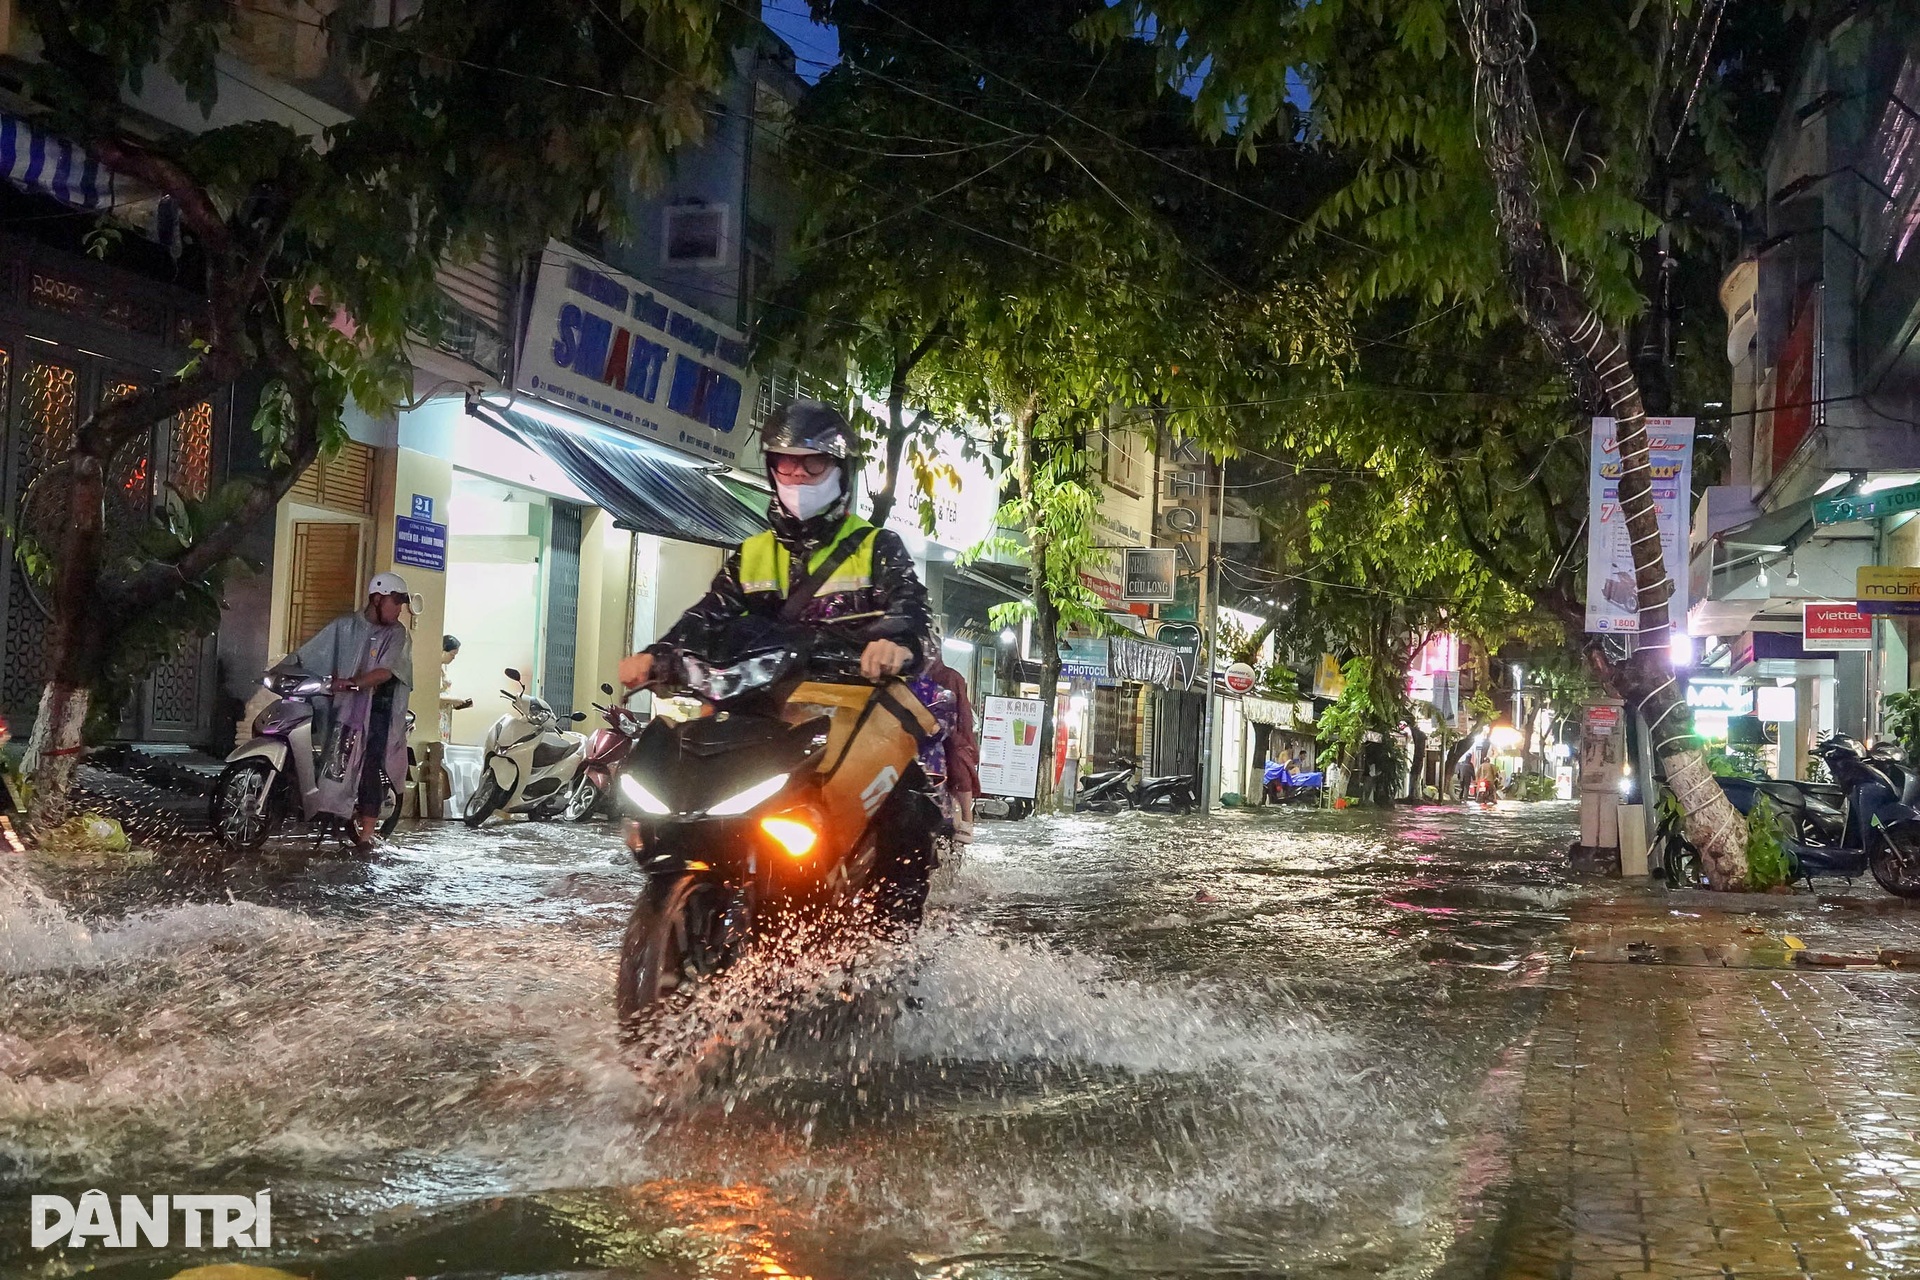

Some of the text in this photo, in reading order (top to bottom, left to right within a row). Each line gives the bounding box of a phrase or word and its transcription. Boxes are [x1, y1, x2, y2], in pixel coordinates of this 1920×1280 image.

[552, 304, 669, 404] SMART
[415, 497, 430, 512] 21
[946, 507, 957, 523] TEA
[1129, 577, 1168, 593] CỬU LONG
[1817, 610, 1863, 620] viettel
[1614, 619, 1635, 627] 1800
[1810, 625, 1826, 634] ĐIỂM
[1176, 646, 1193, 654] LONG
[1067, 664, 1106, 676] PHOTOCO
